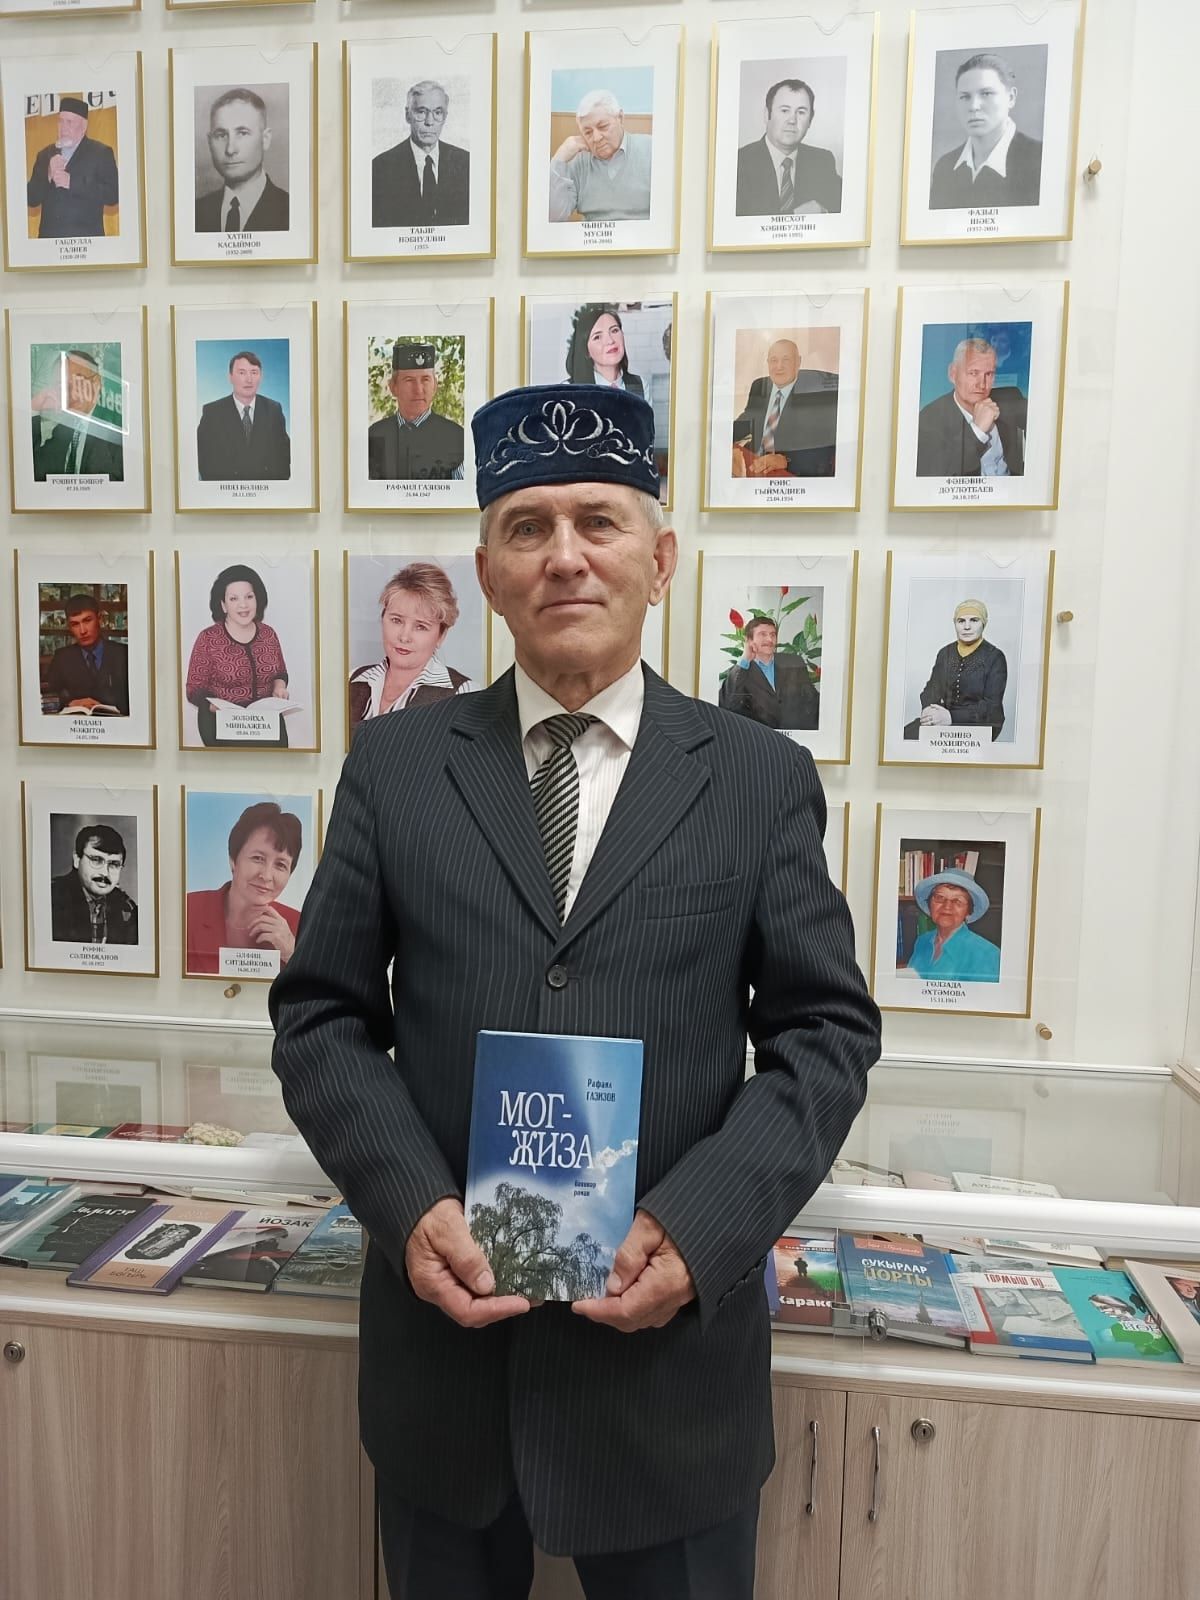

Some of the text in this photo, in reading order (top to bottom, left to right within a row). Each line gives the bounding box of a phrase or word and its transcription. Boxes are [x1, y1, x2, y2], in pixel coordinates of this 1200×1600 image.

[587, 1078, 612, 1089] Рафаил
[586, 1091, 616, 1102] ГАЗИЗОВ
[498, 1090, 572, 1129] МОГ-
[509, 1130, 594, 1174] ҖИЗА
[861, 1258, 928, 1274] СУКЫРЛАР
